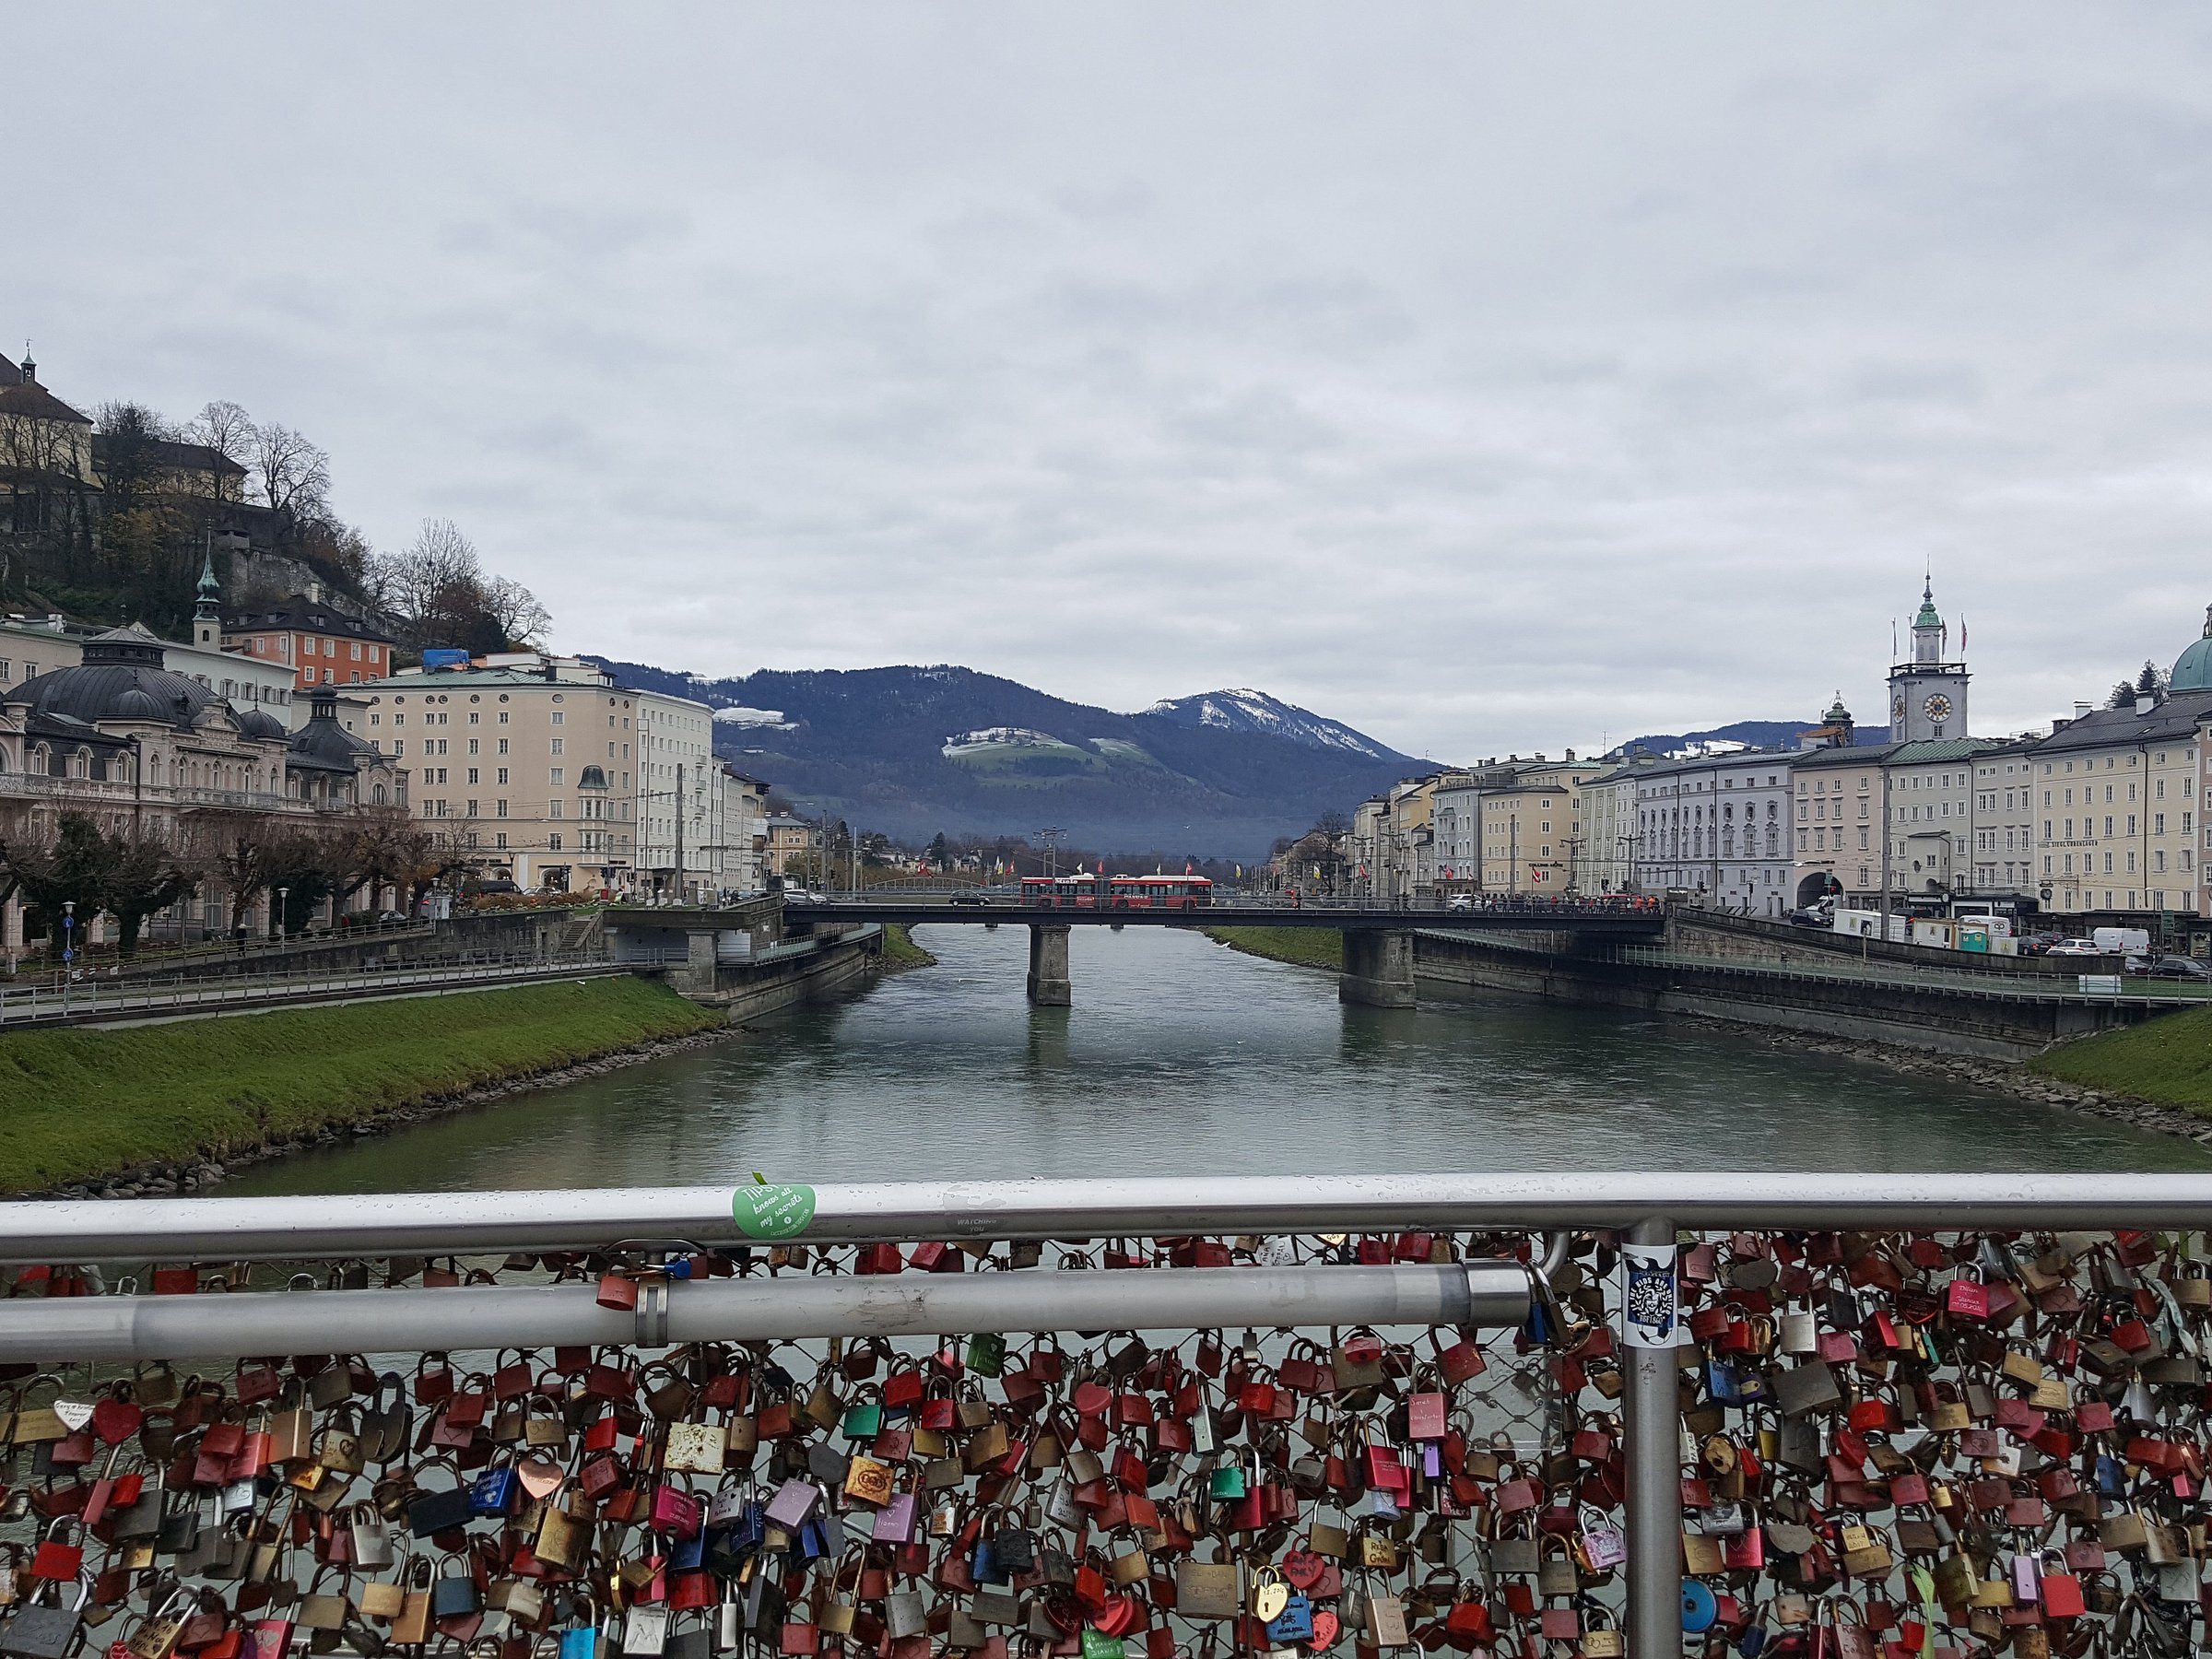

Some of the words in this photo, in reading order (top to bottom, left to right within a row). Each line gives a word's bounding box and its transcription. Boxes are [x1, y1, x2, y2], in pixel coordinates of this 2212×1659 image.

[752, 1194, 780, 1215] knows
[781, 1186, 794, 1197] all
[759, 1215, 773, 1229] my
[774, 1194, 803, 1218] secrets
[1635, 1277, 1653, 1288] KIDS
[1654, 1277, 1668, 1289] ARE
